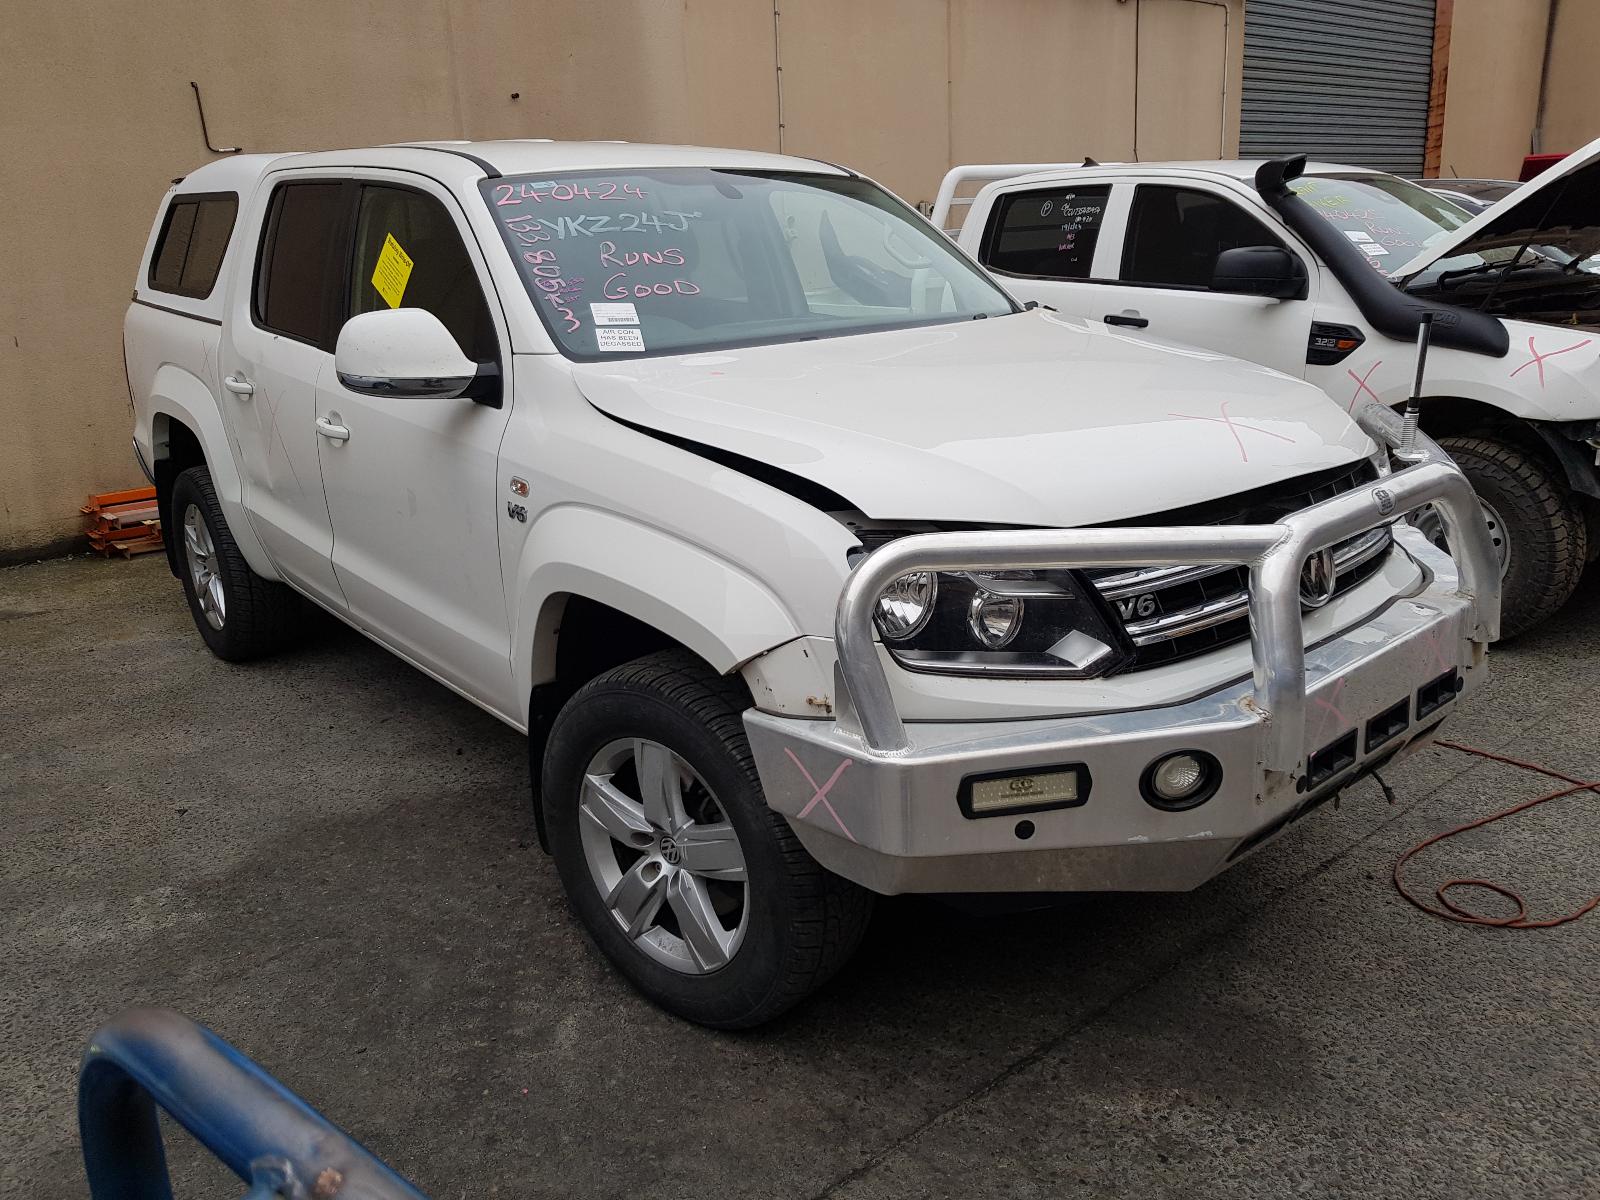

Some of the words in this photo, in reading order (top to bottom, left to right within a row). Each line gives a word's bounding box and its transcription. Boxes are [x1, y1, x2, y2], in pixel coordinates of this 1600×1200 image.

[496, 183, 649, 206] 240424
[600, 241, 685, 268] RUNS
[603, 273, 700, 300] GOOD
[507, 500, 528, 523] V6
[1115, 594, 1156, 620] V6
